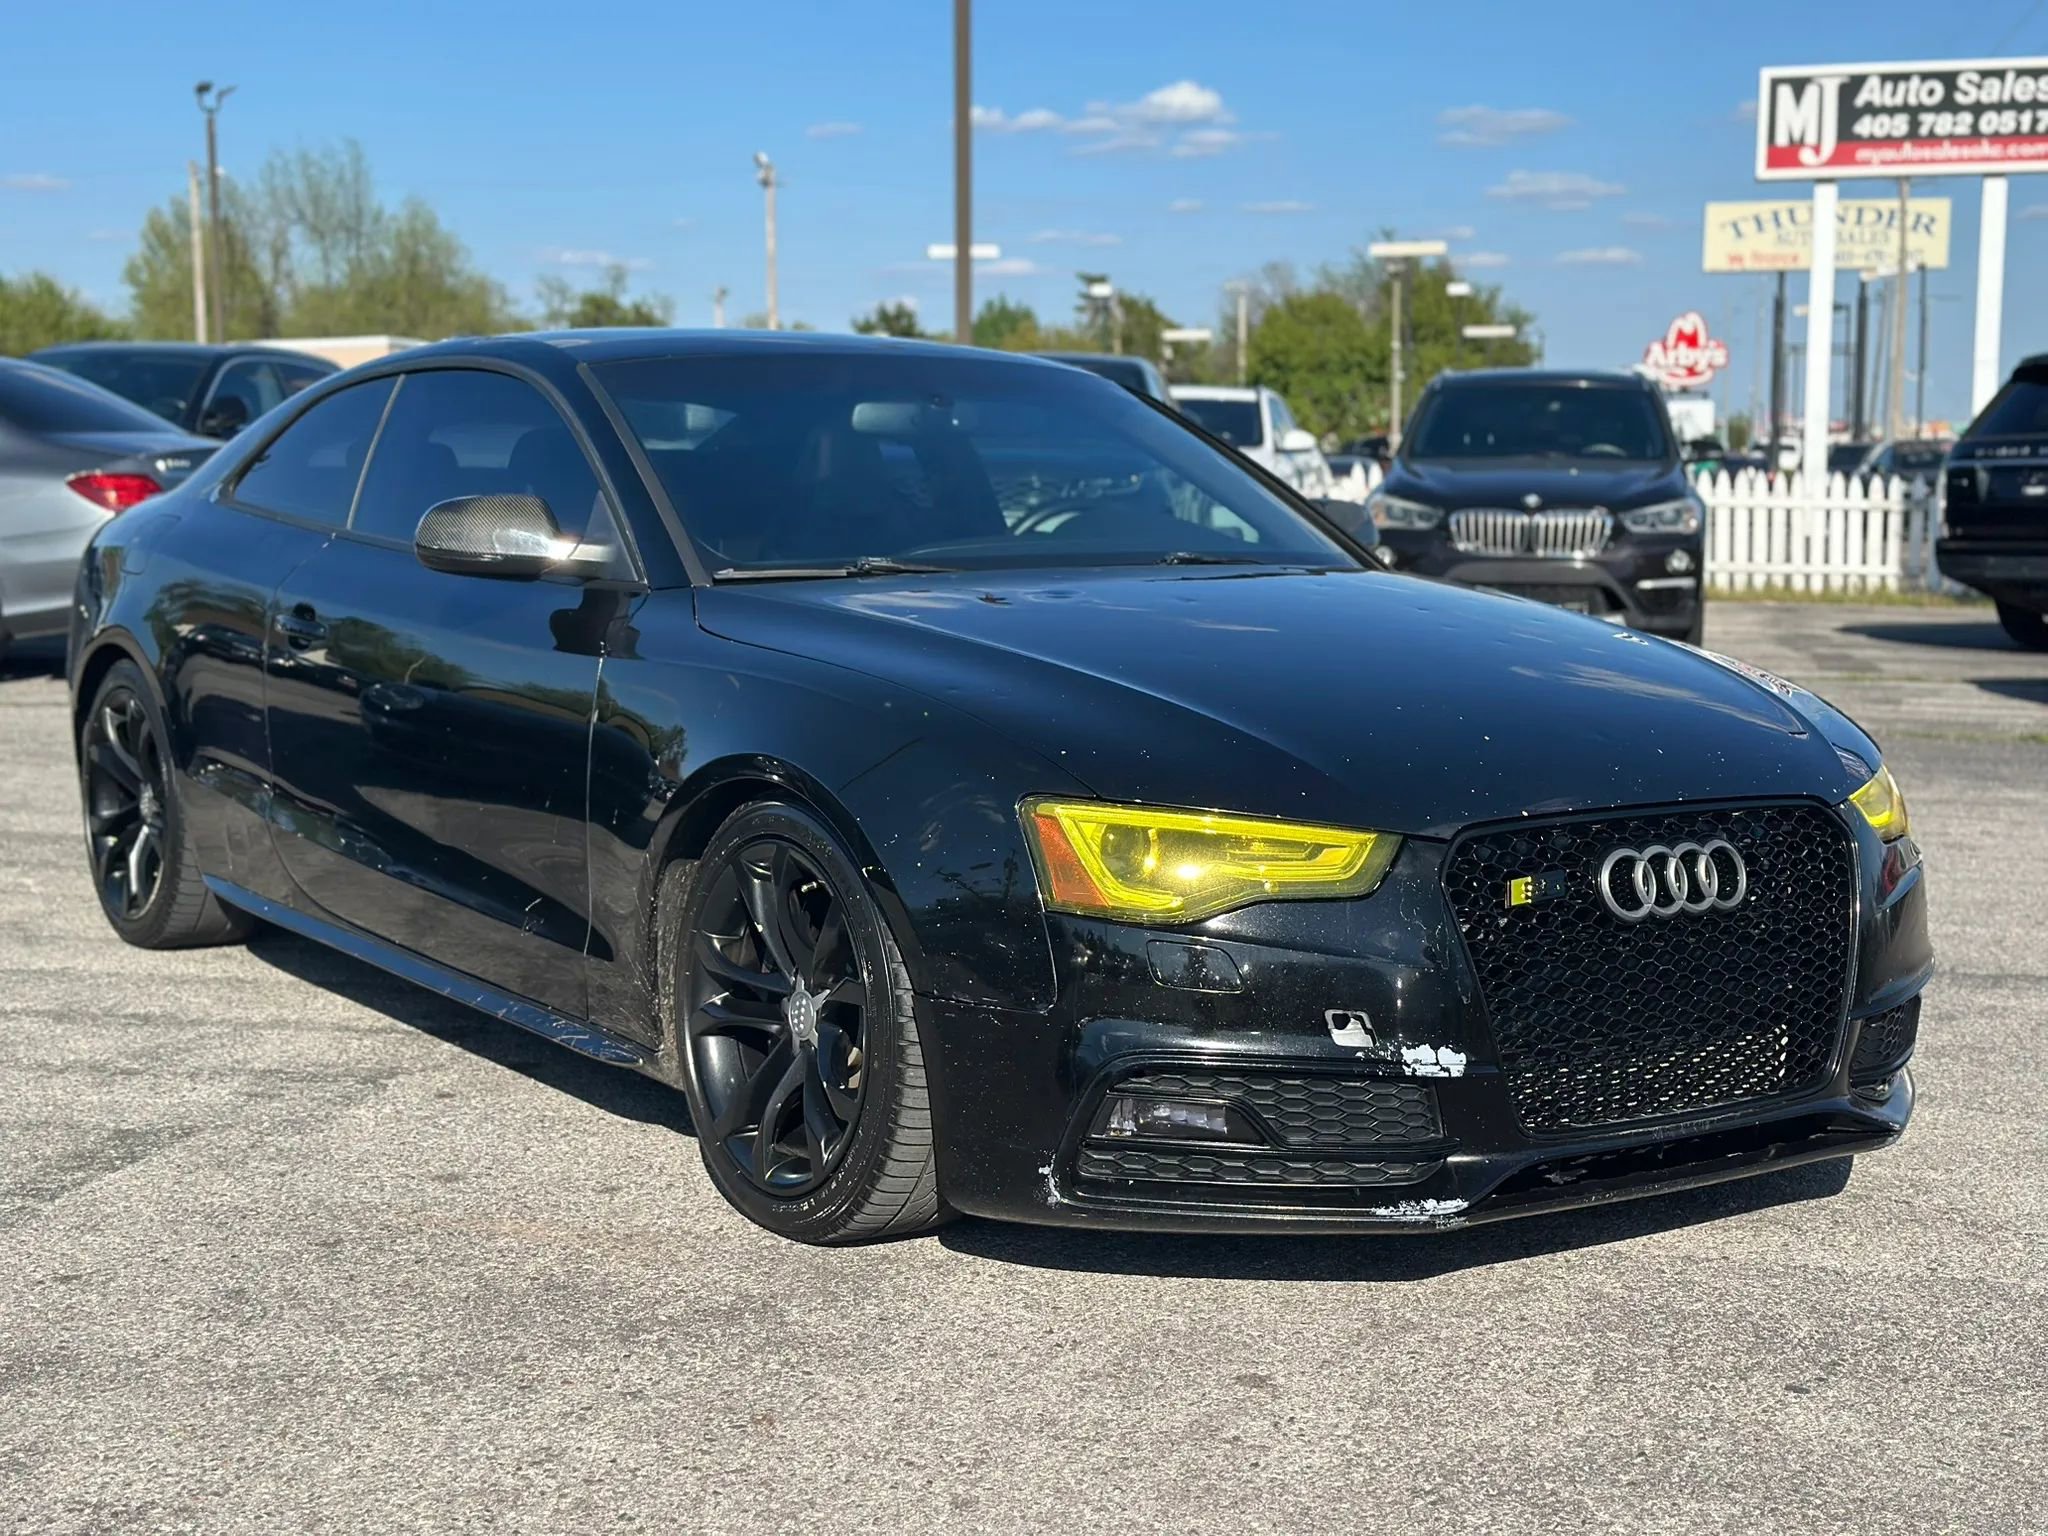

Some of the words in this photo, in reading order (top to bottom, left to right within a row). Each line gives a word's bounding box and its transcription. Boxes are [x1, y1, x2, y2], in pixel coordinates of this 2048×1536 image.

[1854, 74, 1944, 107] Auto
[1953, 70, 2048, 105] Sales
[1774, 76, 1849, 166] MJ
[1852, 113, 1910, 138] 405
[1916, 112, 1974, 136] 782
[1977, 109, 2048, 134] 0517
[1645, 340, 1727, 372] Arby's
